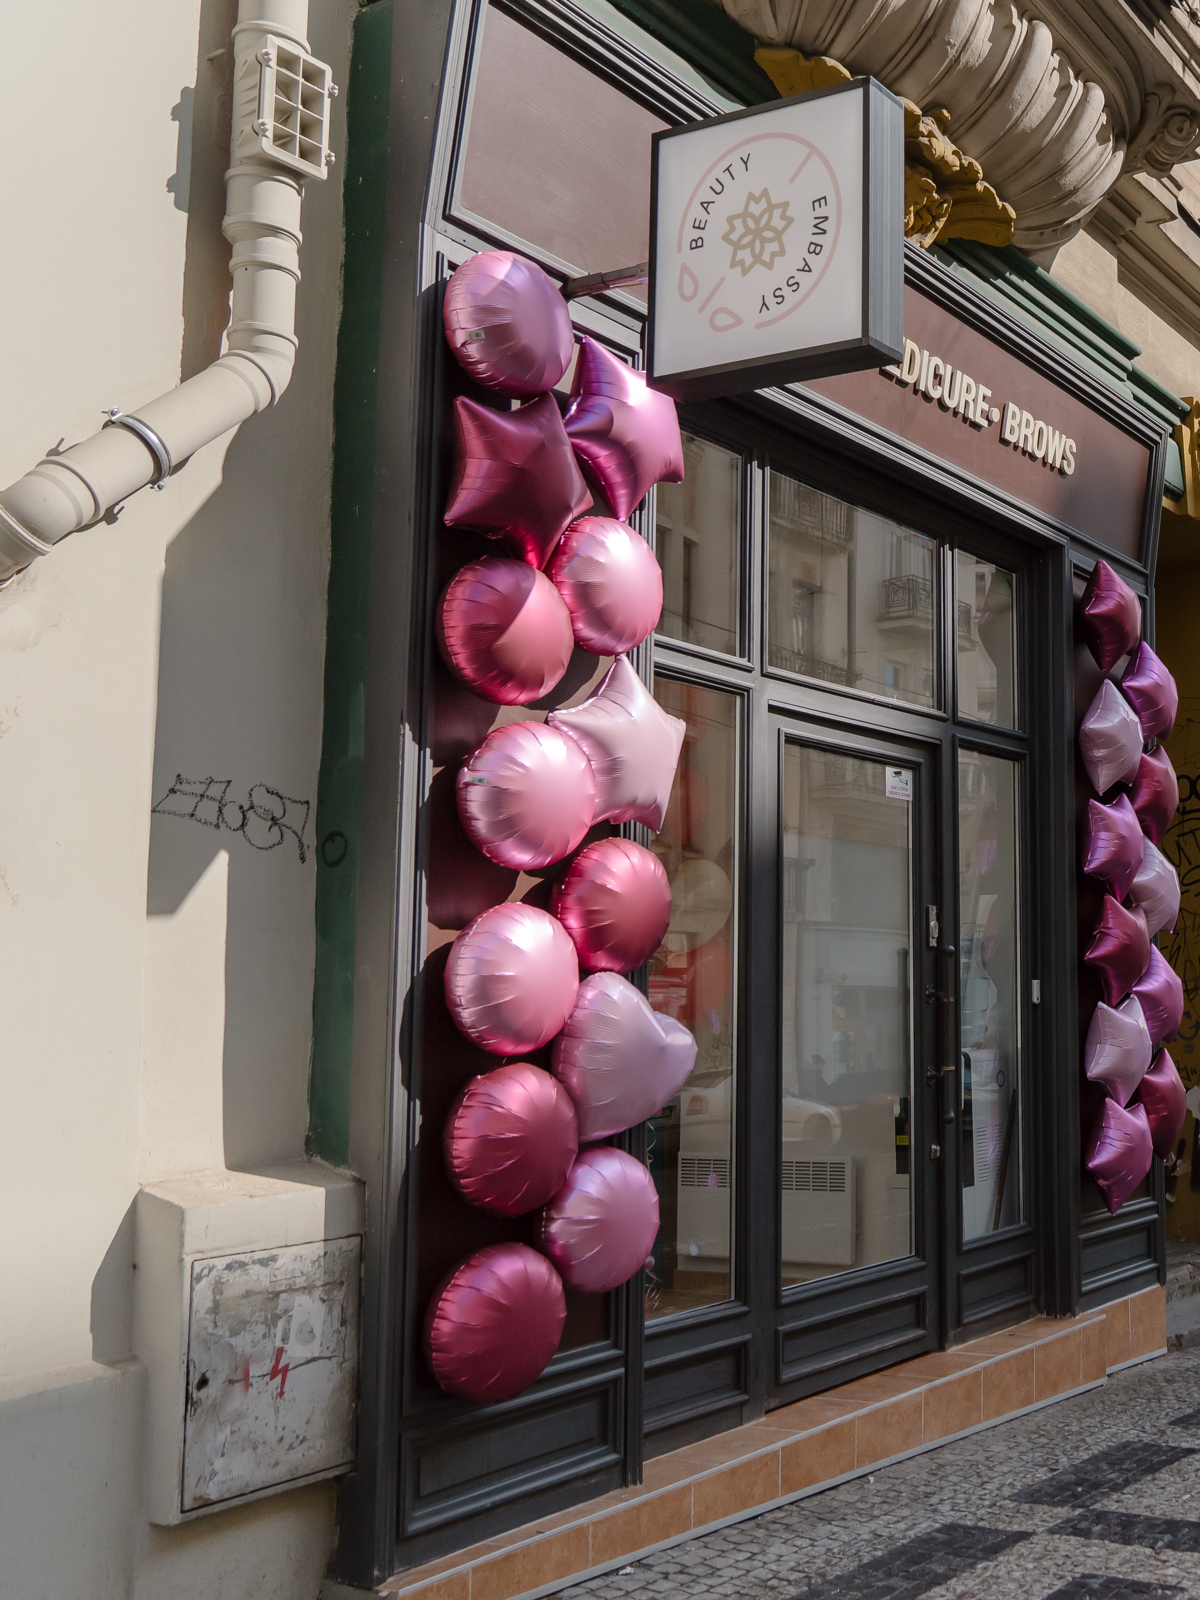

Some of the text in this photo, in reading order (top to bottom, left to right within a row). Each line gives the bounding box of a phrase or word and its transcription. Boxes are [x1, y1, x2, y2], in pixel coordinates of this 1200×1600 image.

[690, 153, 751, 251] BEAUTY
[758, 195, 829, 314] EMBASSY
[1001, 402, 1077, 475] BROWS
